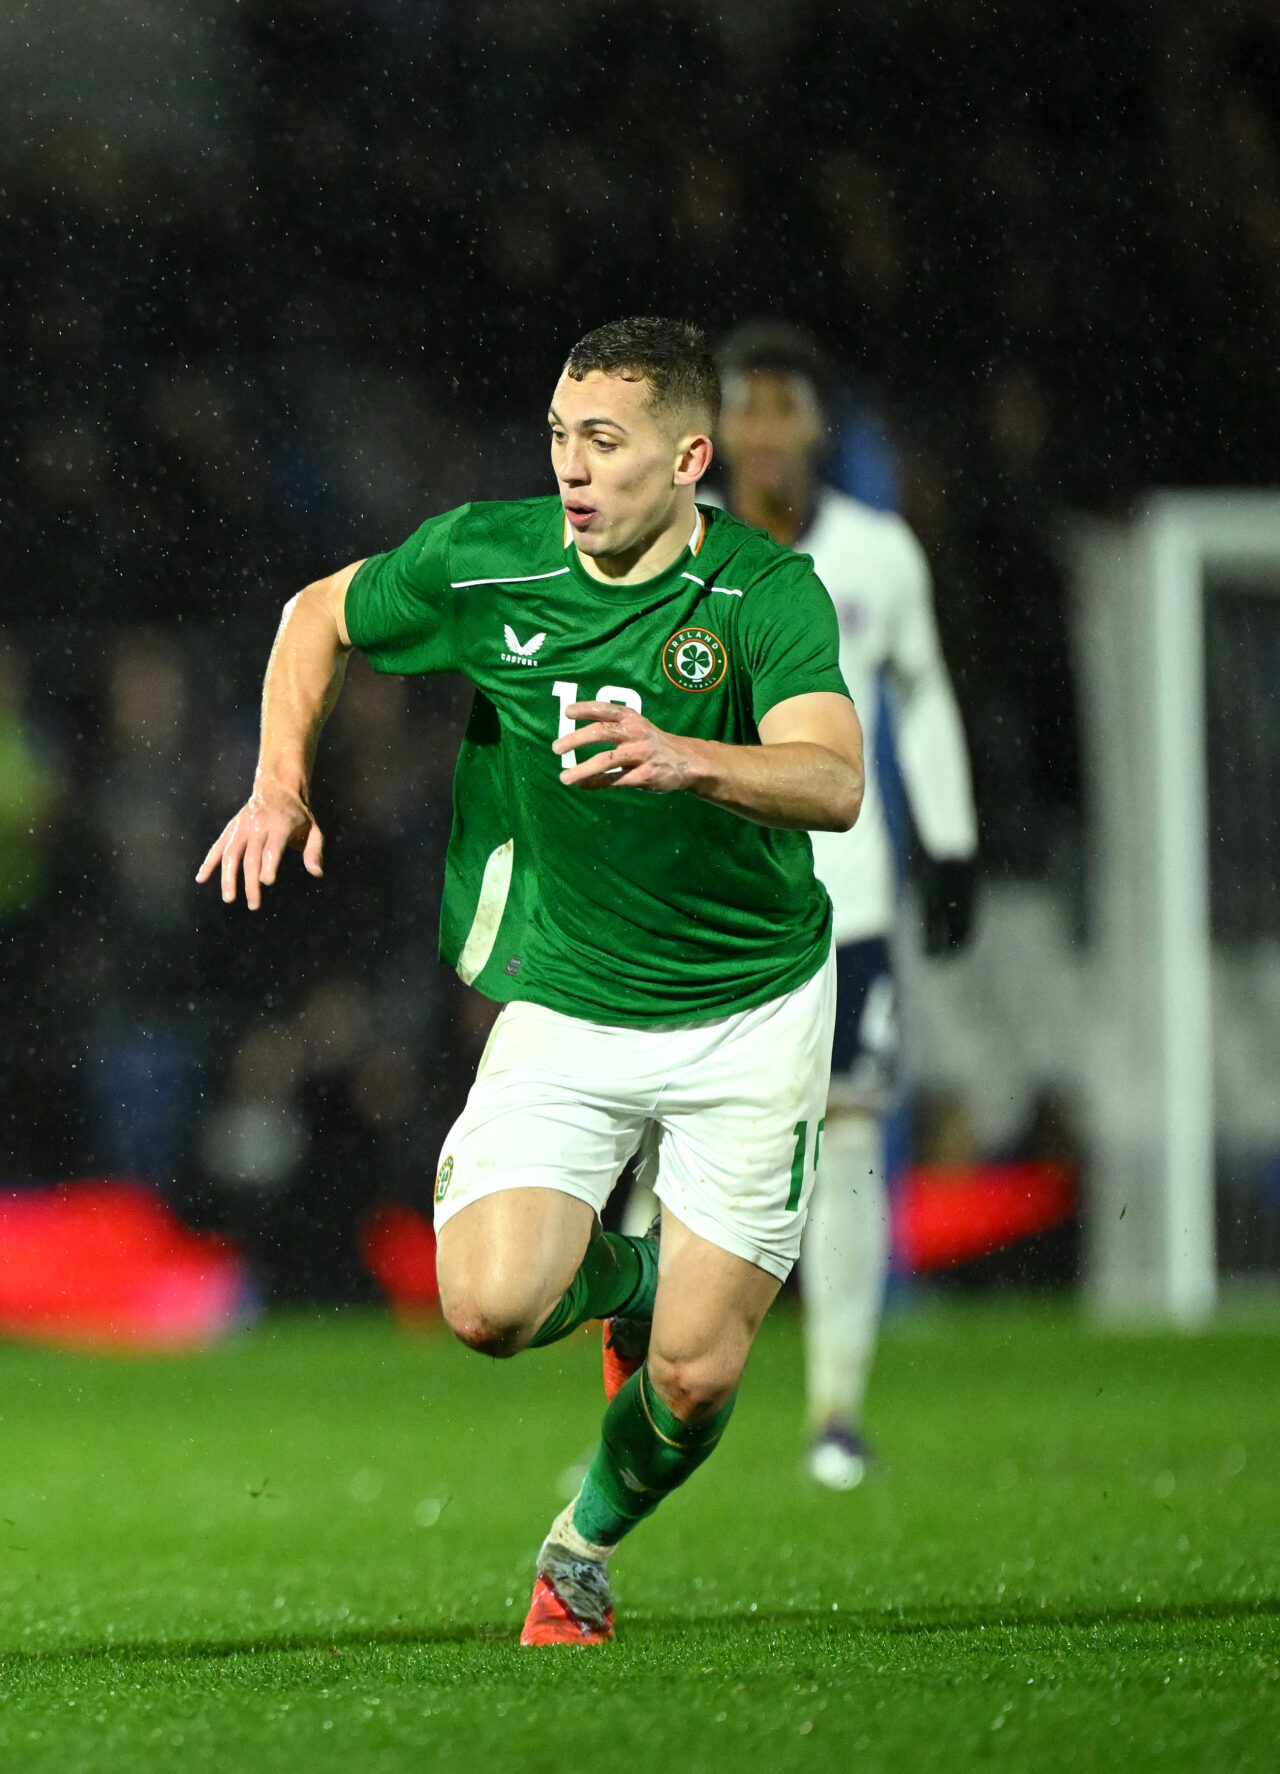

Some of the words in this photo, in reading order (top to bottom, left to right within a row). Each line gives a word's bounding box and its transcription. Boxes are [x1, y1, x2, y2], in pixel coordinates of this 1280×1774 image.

[668, 631, 719, 654] IRELAND
[500, 653, 539, 667] CASTORE
[785, 1117, 826, 1212] 1
